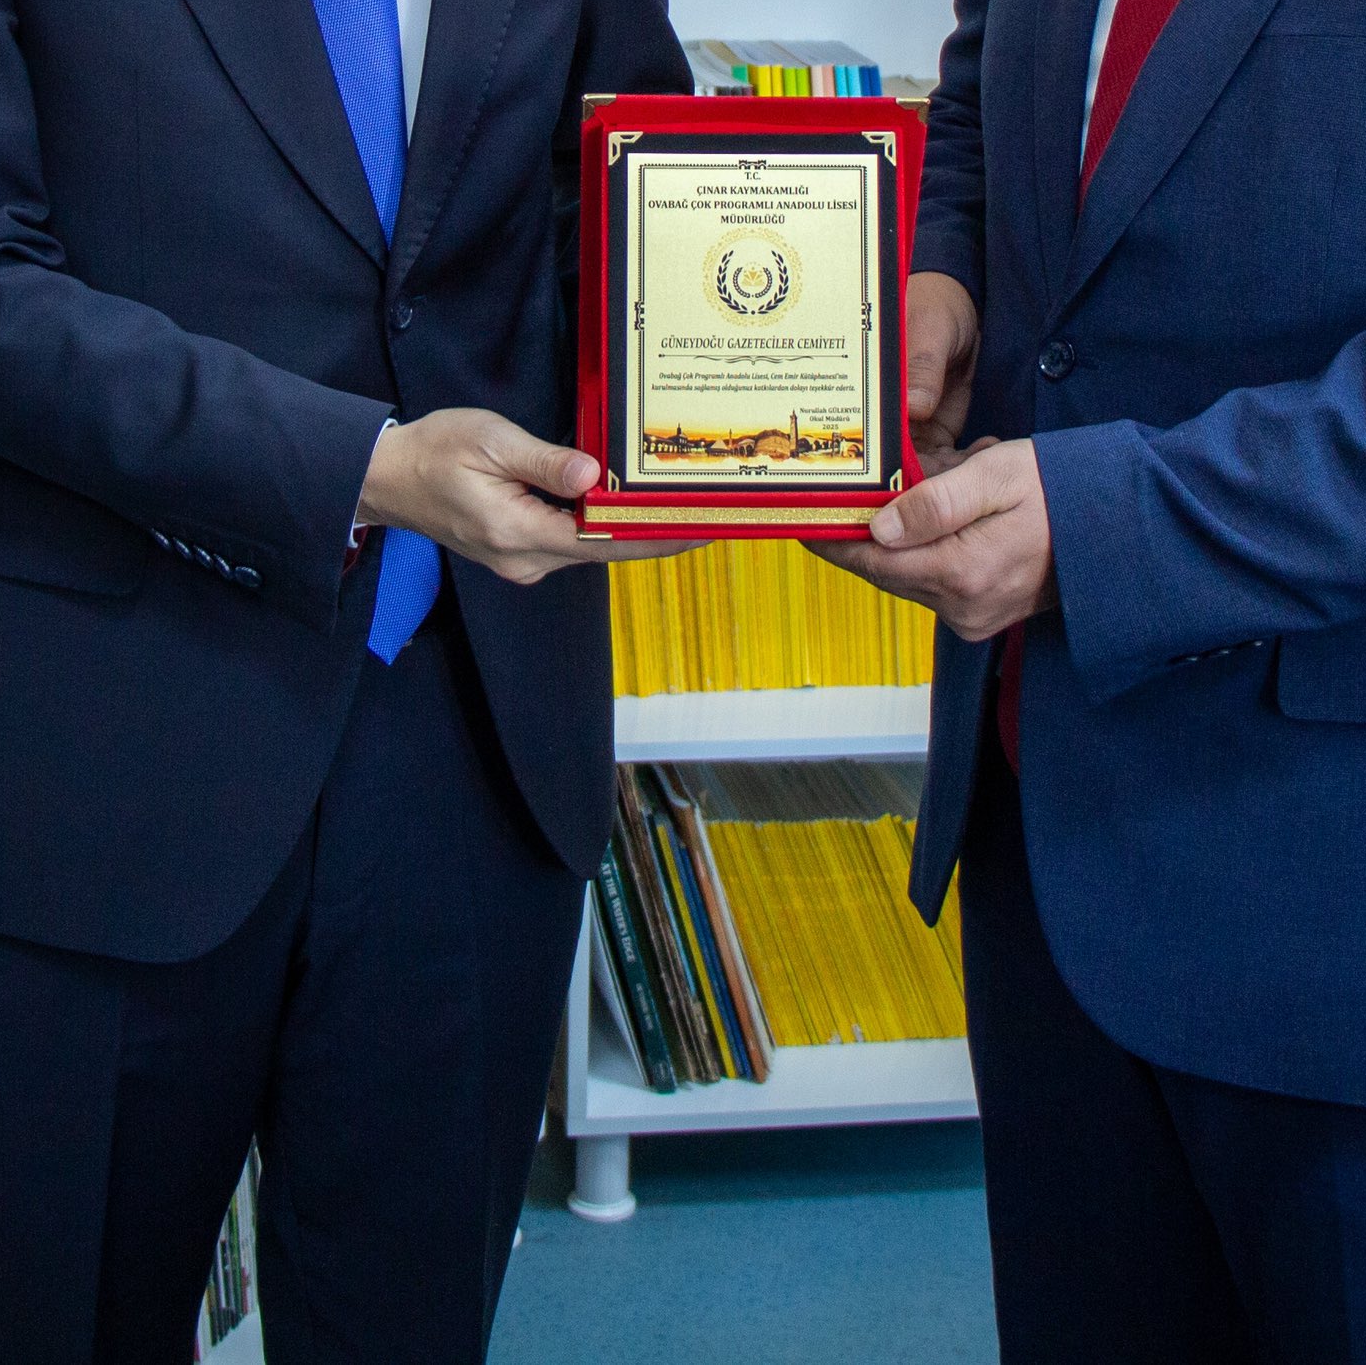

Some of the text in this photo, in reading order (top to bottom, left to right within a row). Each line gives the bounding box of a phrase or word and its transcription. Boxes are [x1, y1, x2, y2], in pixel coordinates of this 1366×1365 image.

[745, 172, 761, 180] T.C.
[697, 185, 809, 196] ÇINAR KAYMAKAMLIĞI
[648, 199, 857, 211] OVABAĞ ÇOK PROGRAMLI ANADOLU LİSESİ
[721, 214, 785, 224] MÜDÜRLÜĞÜ
[661, 336, 845, 349] GÜNEYDOĞU GAZETECİLER CEMİYETİ
[659, 372, 681, 380] Ovabağ
[695, 372, 725, 380] Programlı
